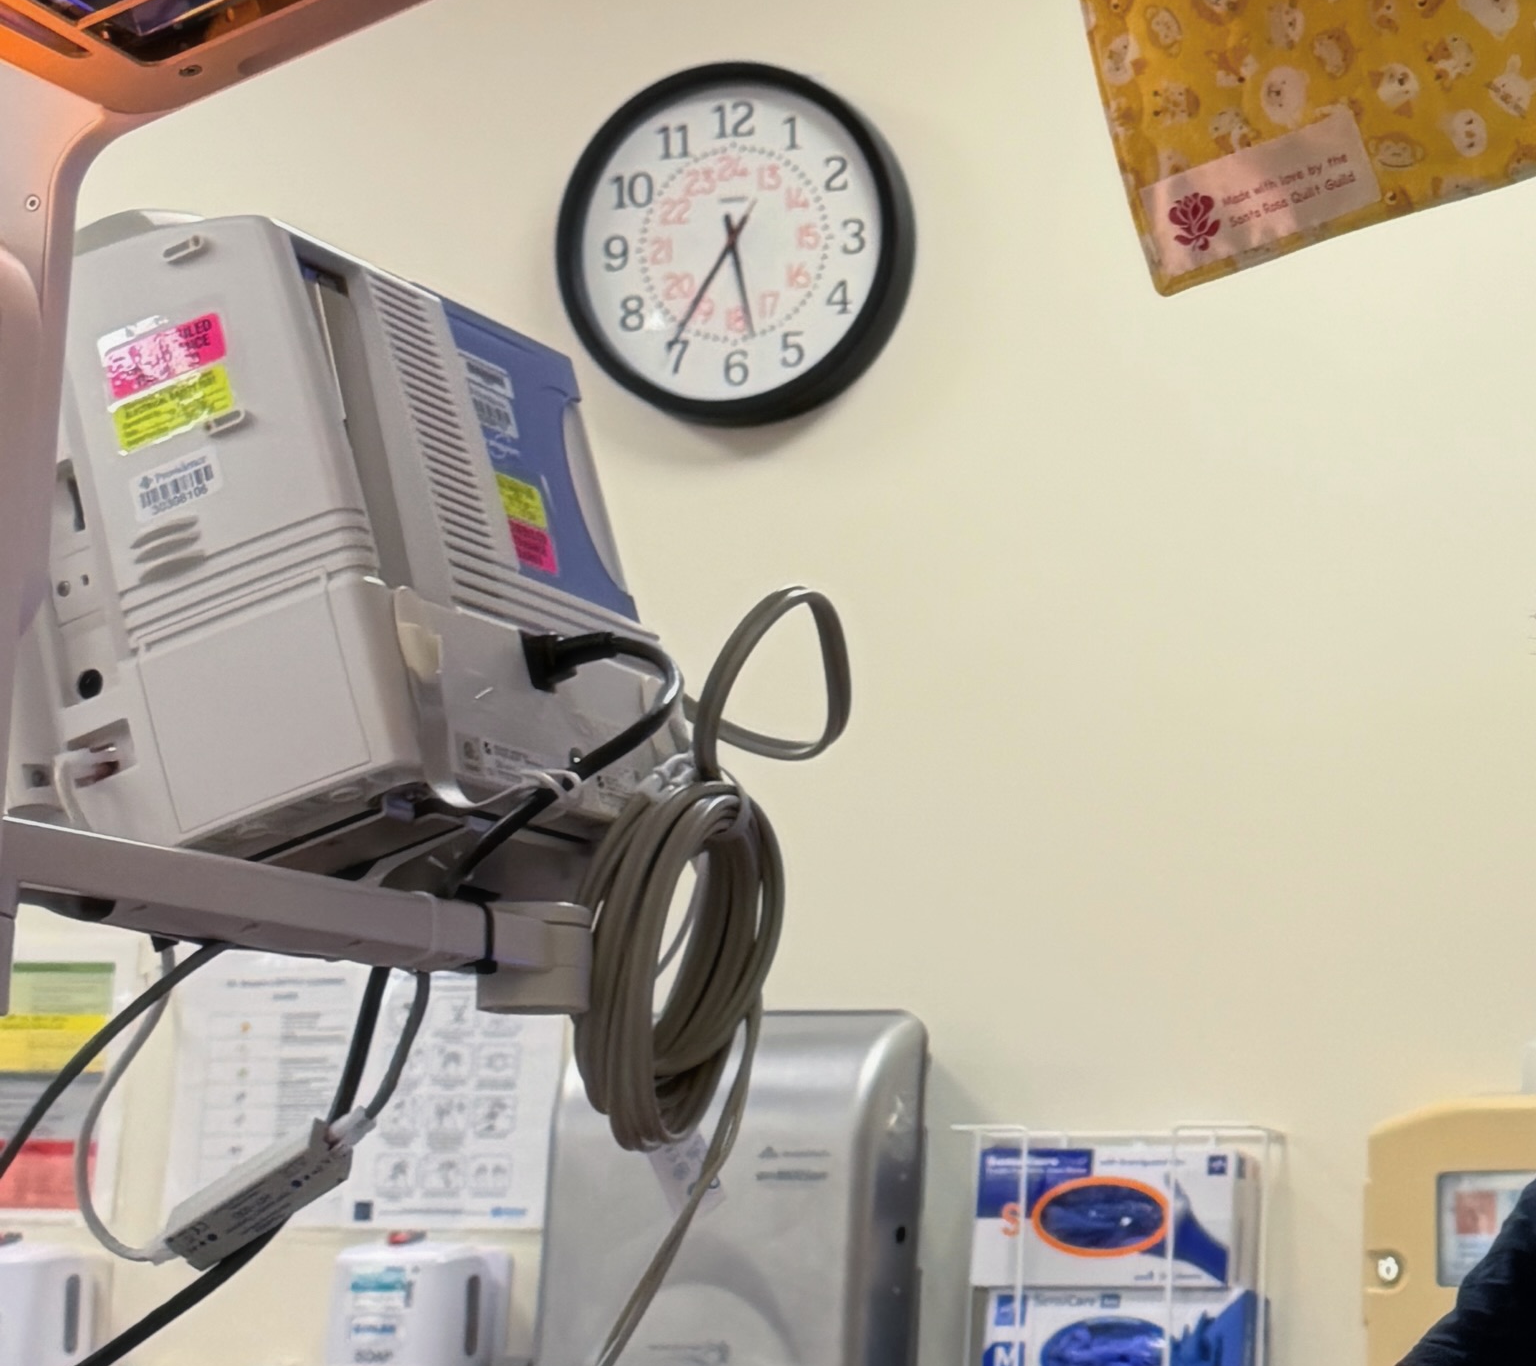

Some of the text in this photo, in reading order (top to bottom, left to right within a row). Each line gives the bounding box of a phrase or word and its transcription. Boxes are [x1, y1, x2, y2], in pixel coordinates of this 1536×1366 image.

[711, 100, 755, 140] 12
[782, 116, 802, 151] 1
[655, 124, 692, 160] 11
[685, 167, 716, 197] 23
[717, 155, 750, 182] 24
[756, 164, 782, 191] 13
[824, 156, 848, 192] 2
[1306, 163, 1322, 177] by
[1327, 153, 1347, 167] the
[1324, 170, 1356, 191] Guild
[611, 173, 654, 209] 10
[660, 196, 691, 226] 22
[603, 235, 629, 272] 9
[650, 236, 673, 266] 21
[796, 223, 821, 251] 15
[840, 218, 866, 255] 3
[662, 271, 695, 301] 20
[785, 261, 812, 289] 16
[620, 295, 644, 332] 8
[758, 291, 780, 319] 17
[826, 280, 852, 316] 4
[666, 338, 689, 374] 7
[781, 331, 804, 367] 5
[724, 350, 749, 386] 6
[1001, 1201, 1021, 1238] S
